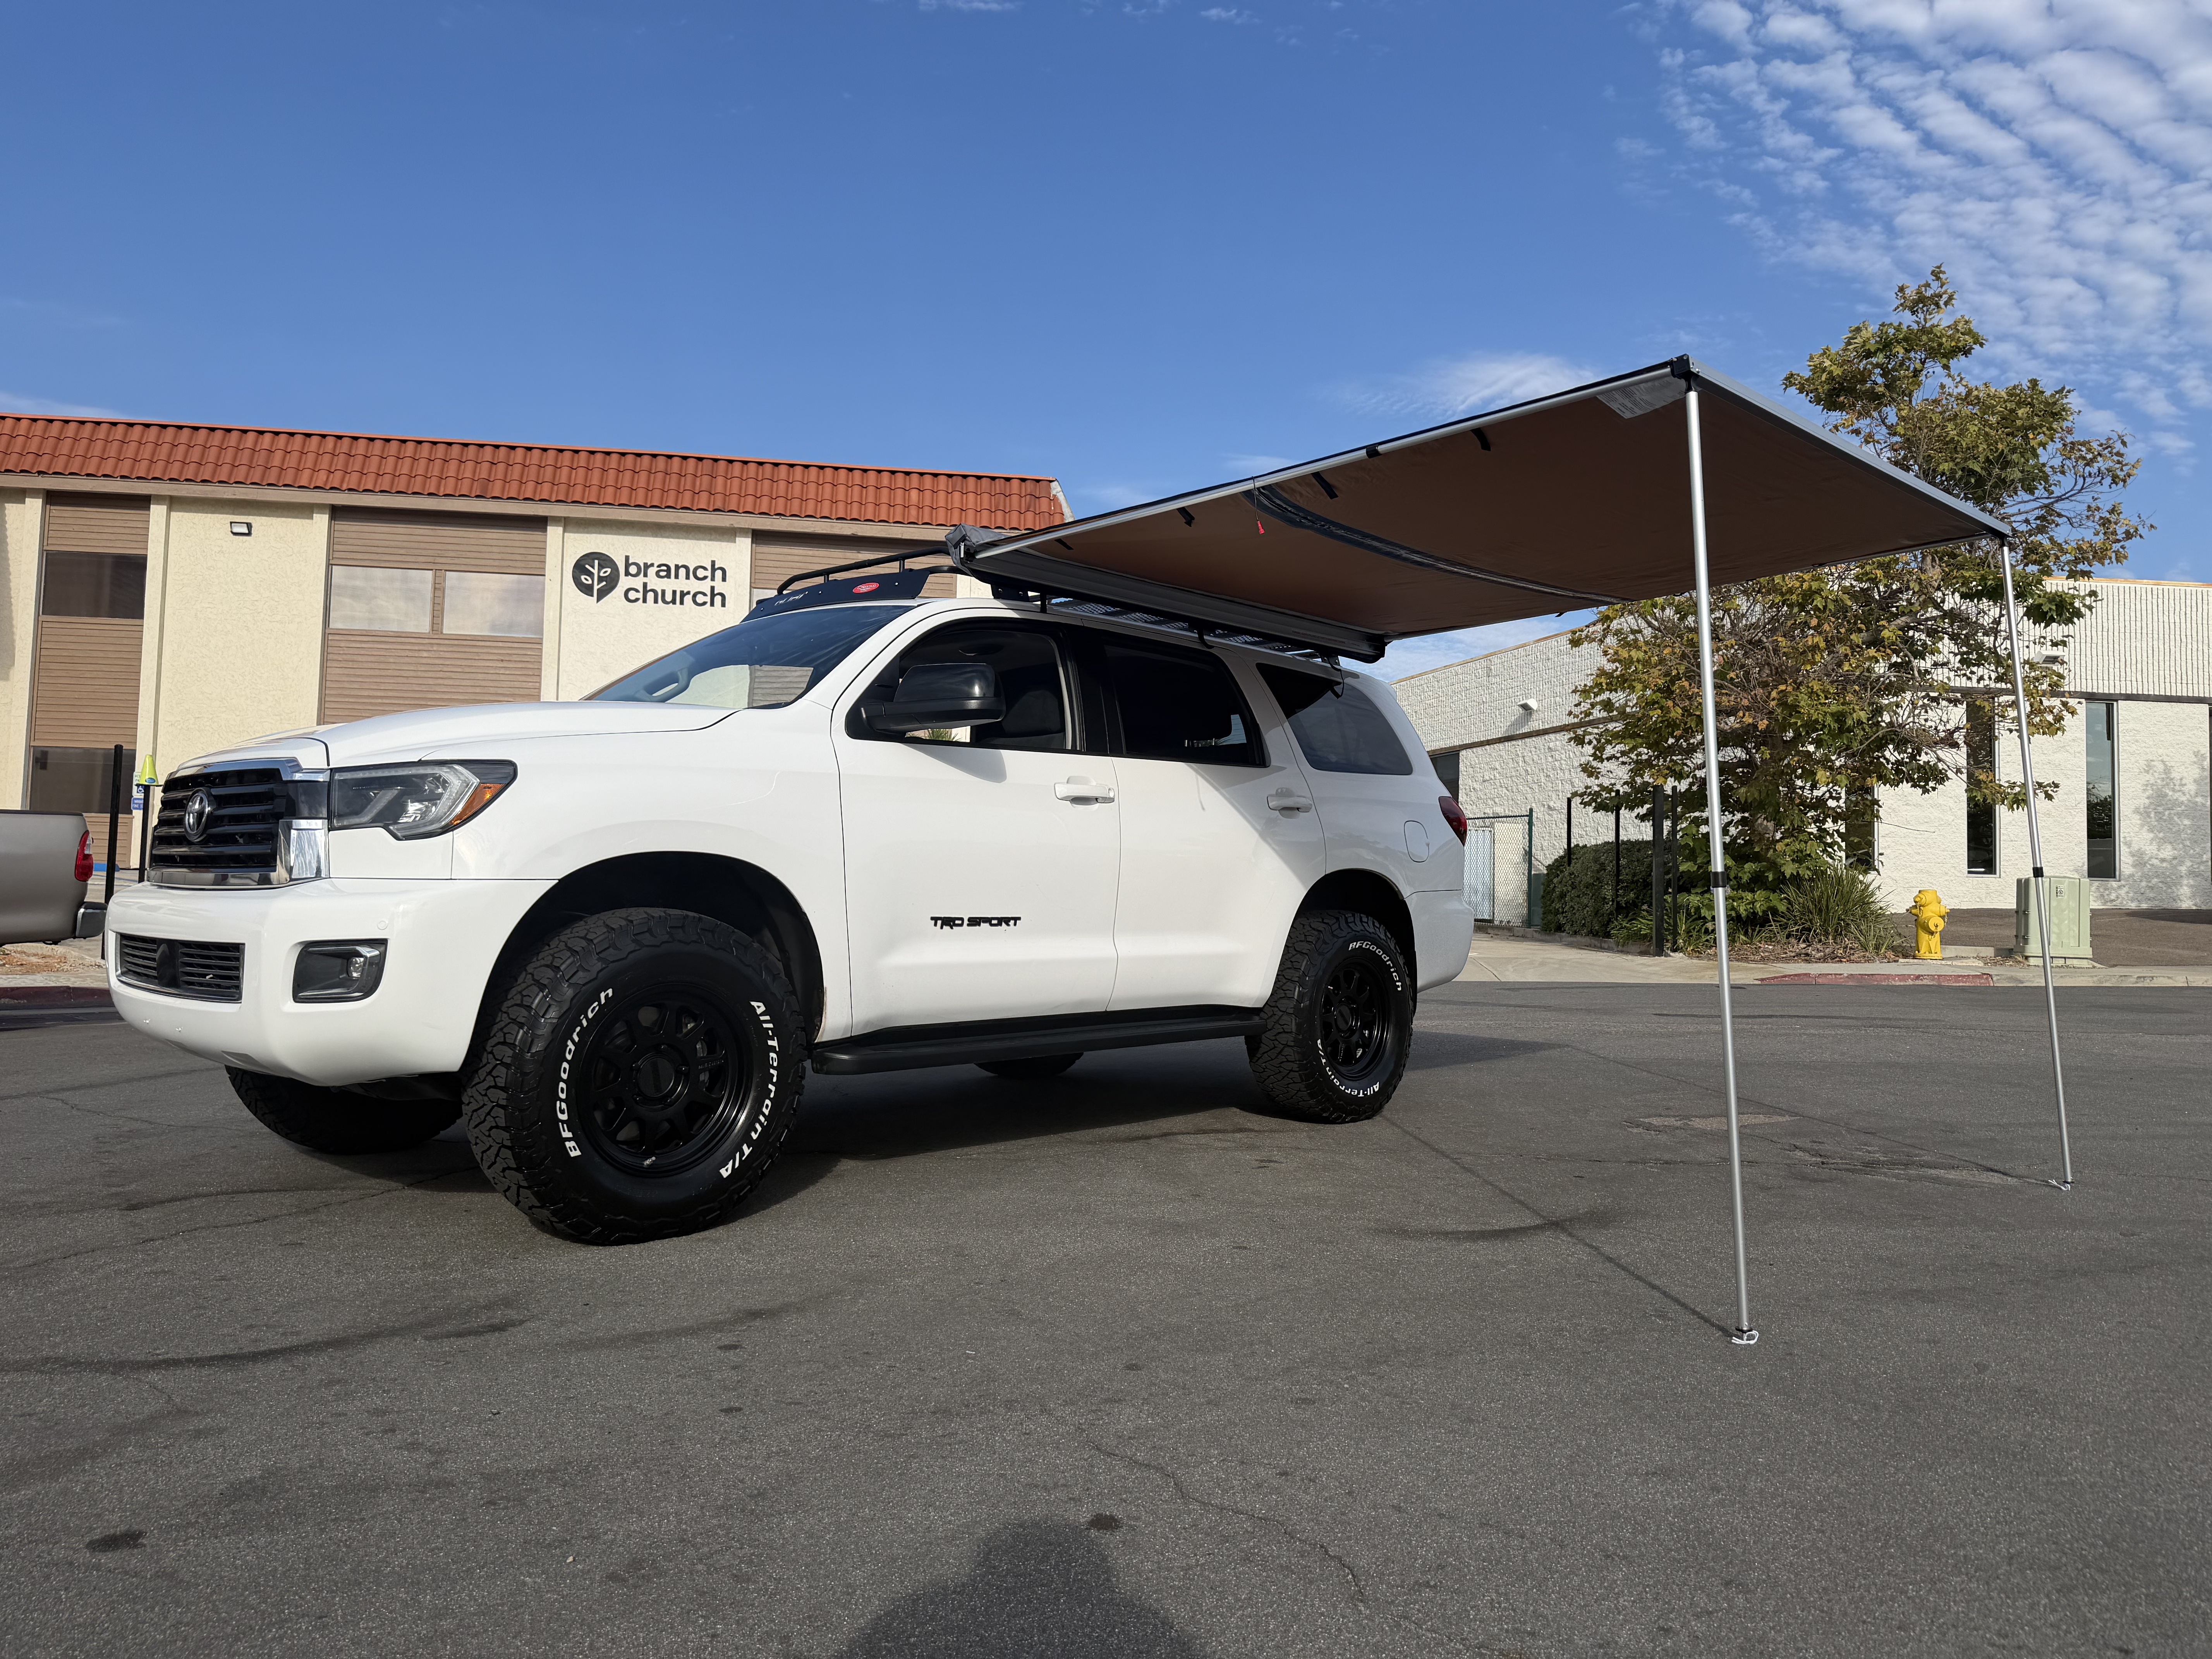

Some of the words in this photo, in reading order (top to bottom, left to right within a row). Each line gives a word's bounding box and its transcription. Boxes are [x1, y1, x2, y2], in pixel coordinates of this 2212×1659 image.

[624, 555, 726, 582] branch
[623, 582, 726, 608] church
[930, 916, 965, 930] TRD
[967, 916, 1022, 927] SPORT
[1348, 941, 1402, 991] BFGoodrich
[556, 988, 613, 1158] BFGoodrich
[750, 1001, 779, 1140] All-Terrain
[1326, 1066, 1379, 1097] All-Terrain
[719, 1143, 753, 1178] T/A
